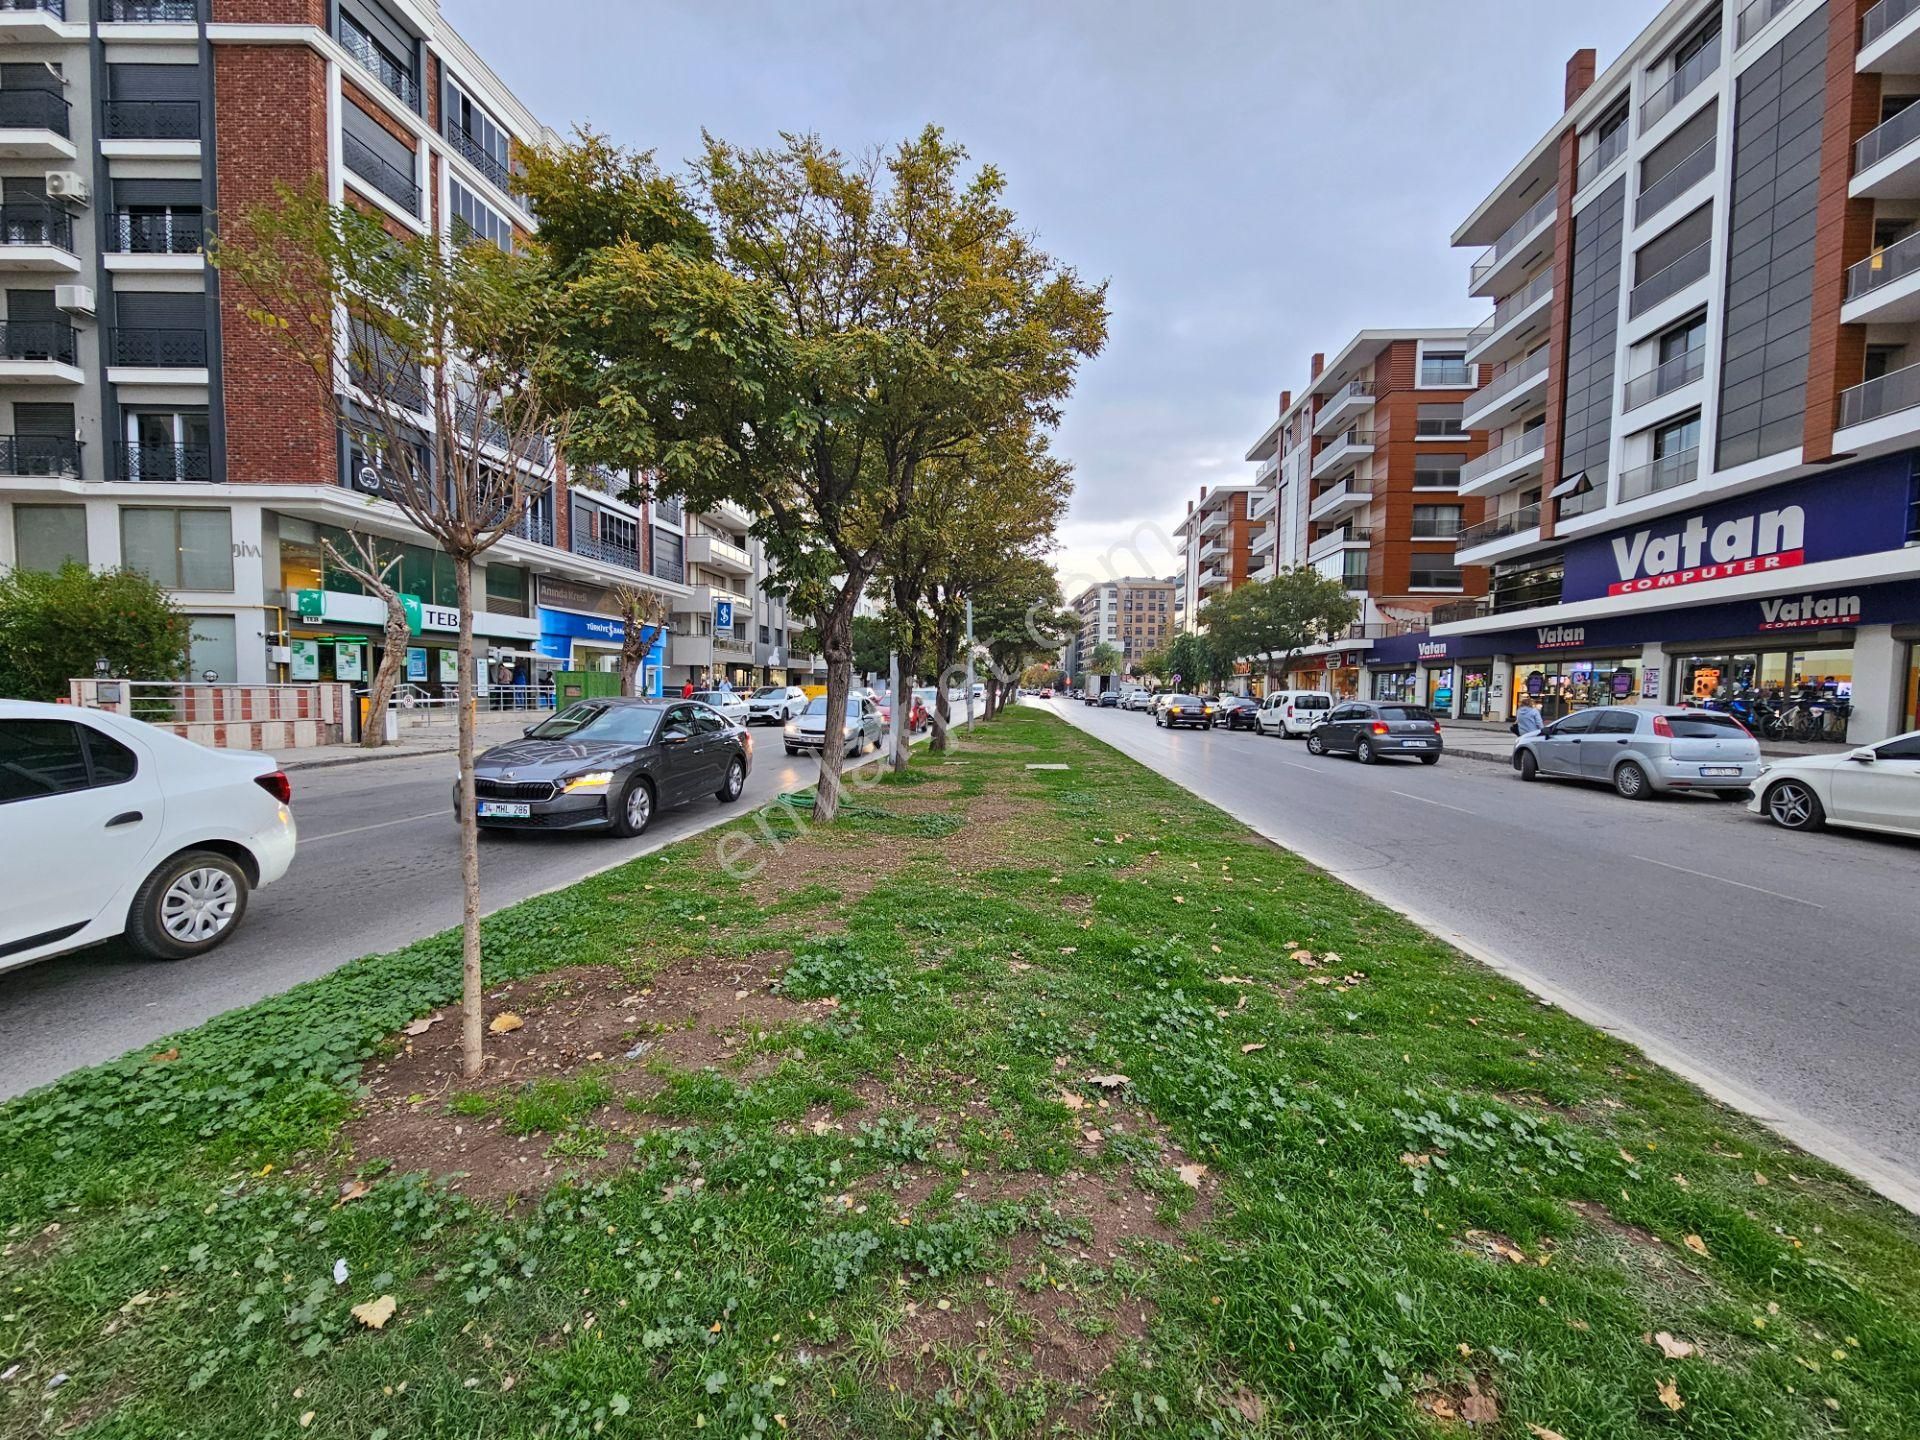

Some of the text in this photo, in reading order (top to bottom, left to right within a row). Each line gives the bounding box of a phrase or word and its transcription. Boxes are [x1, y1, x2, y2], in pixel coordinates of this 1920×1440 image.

[1611, 505, 1805, 581] Vatan
[1621, 556, 1781, 592] COMPUTER
[1760, 595, 1860, 623] Vatan
[426, 610, 458, 627] TEB
[1765, 616, 1851, 629] COMPUTER
[1537, 626, 1585, 644] Vatan
[1418, 641, 1447, 655] Vatan
